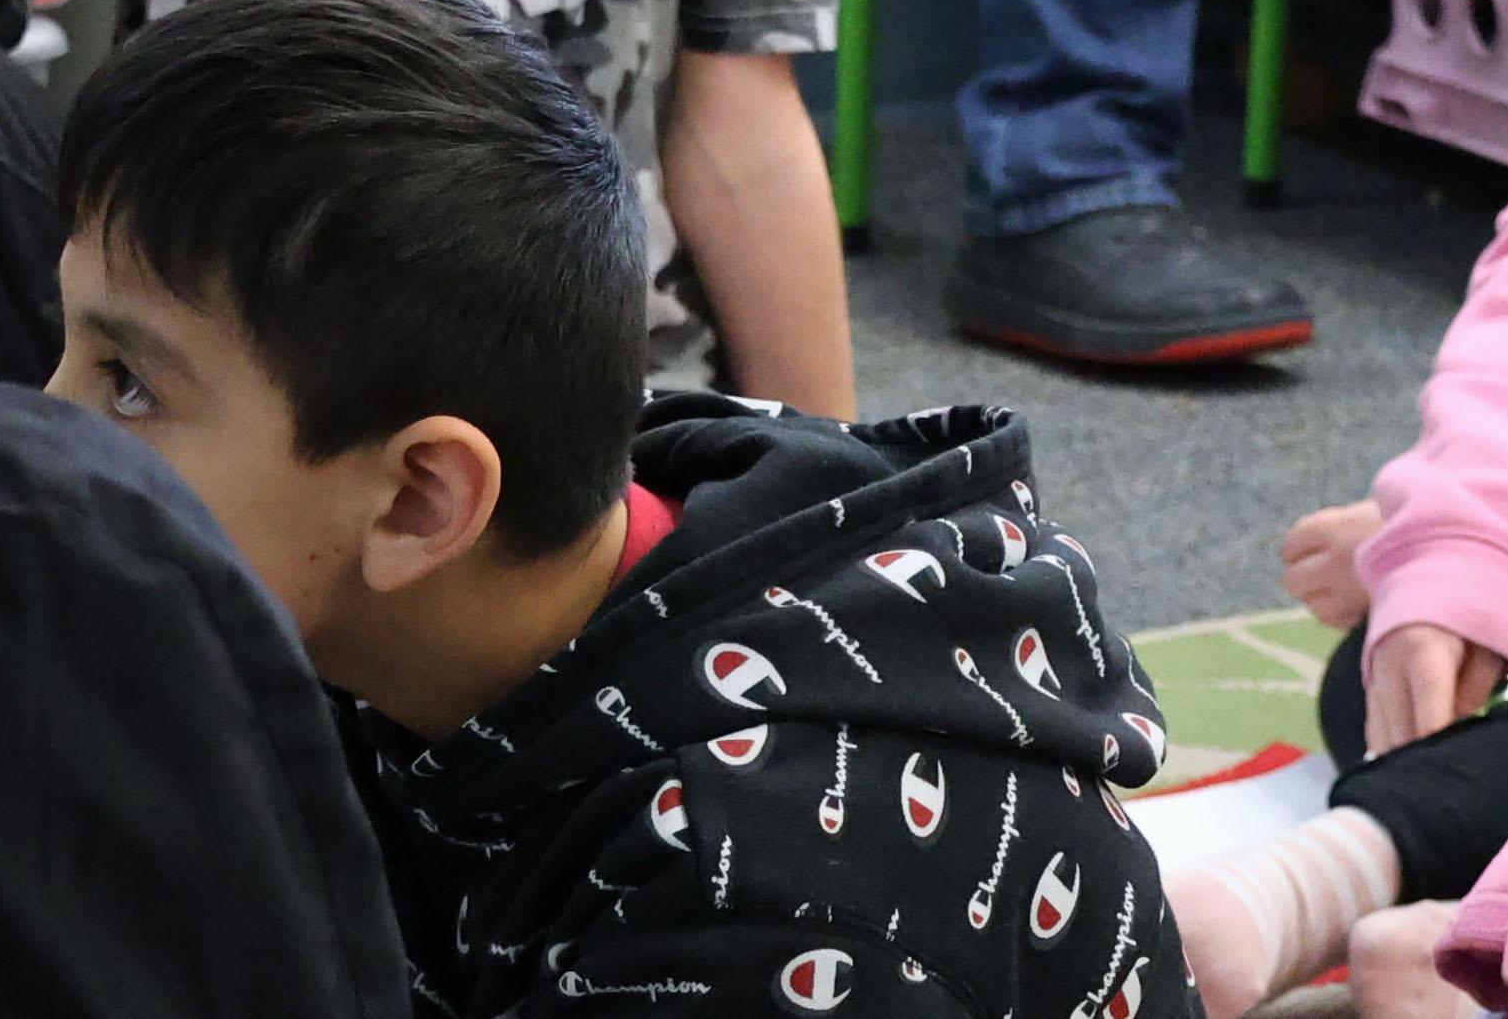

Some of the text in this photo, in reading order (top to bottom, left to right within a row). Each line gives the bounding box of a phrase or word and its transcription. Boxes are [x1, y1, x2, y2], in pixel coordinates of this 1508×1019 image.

[763, 587, 882, 683] Champion
[968, 772, 1021, 929] Champion
[558, 970, 712, 1003] Champion
[1069, 881, 1137, 1019] Champion
